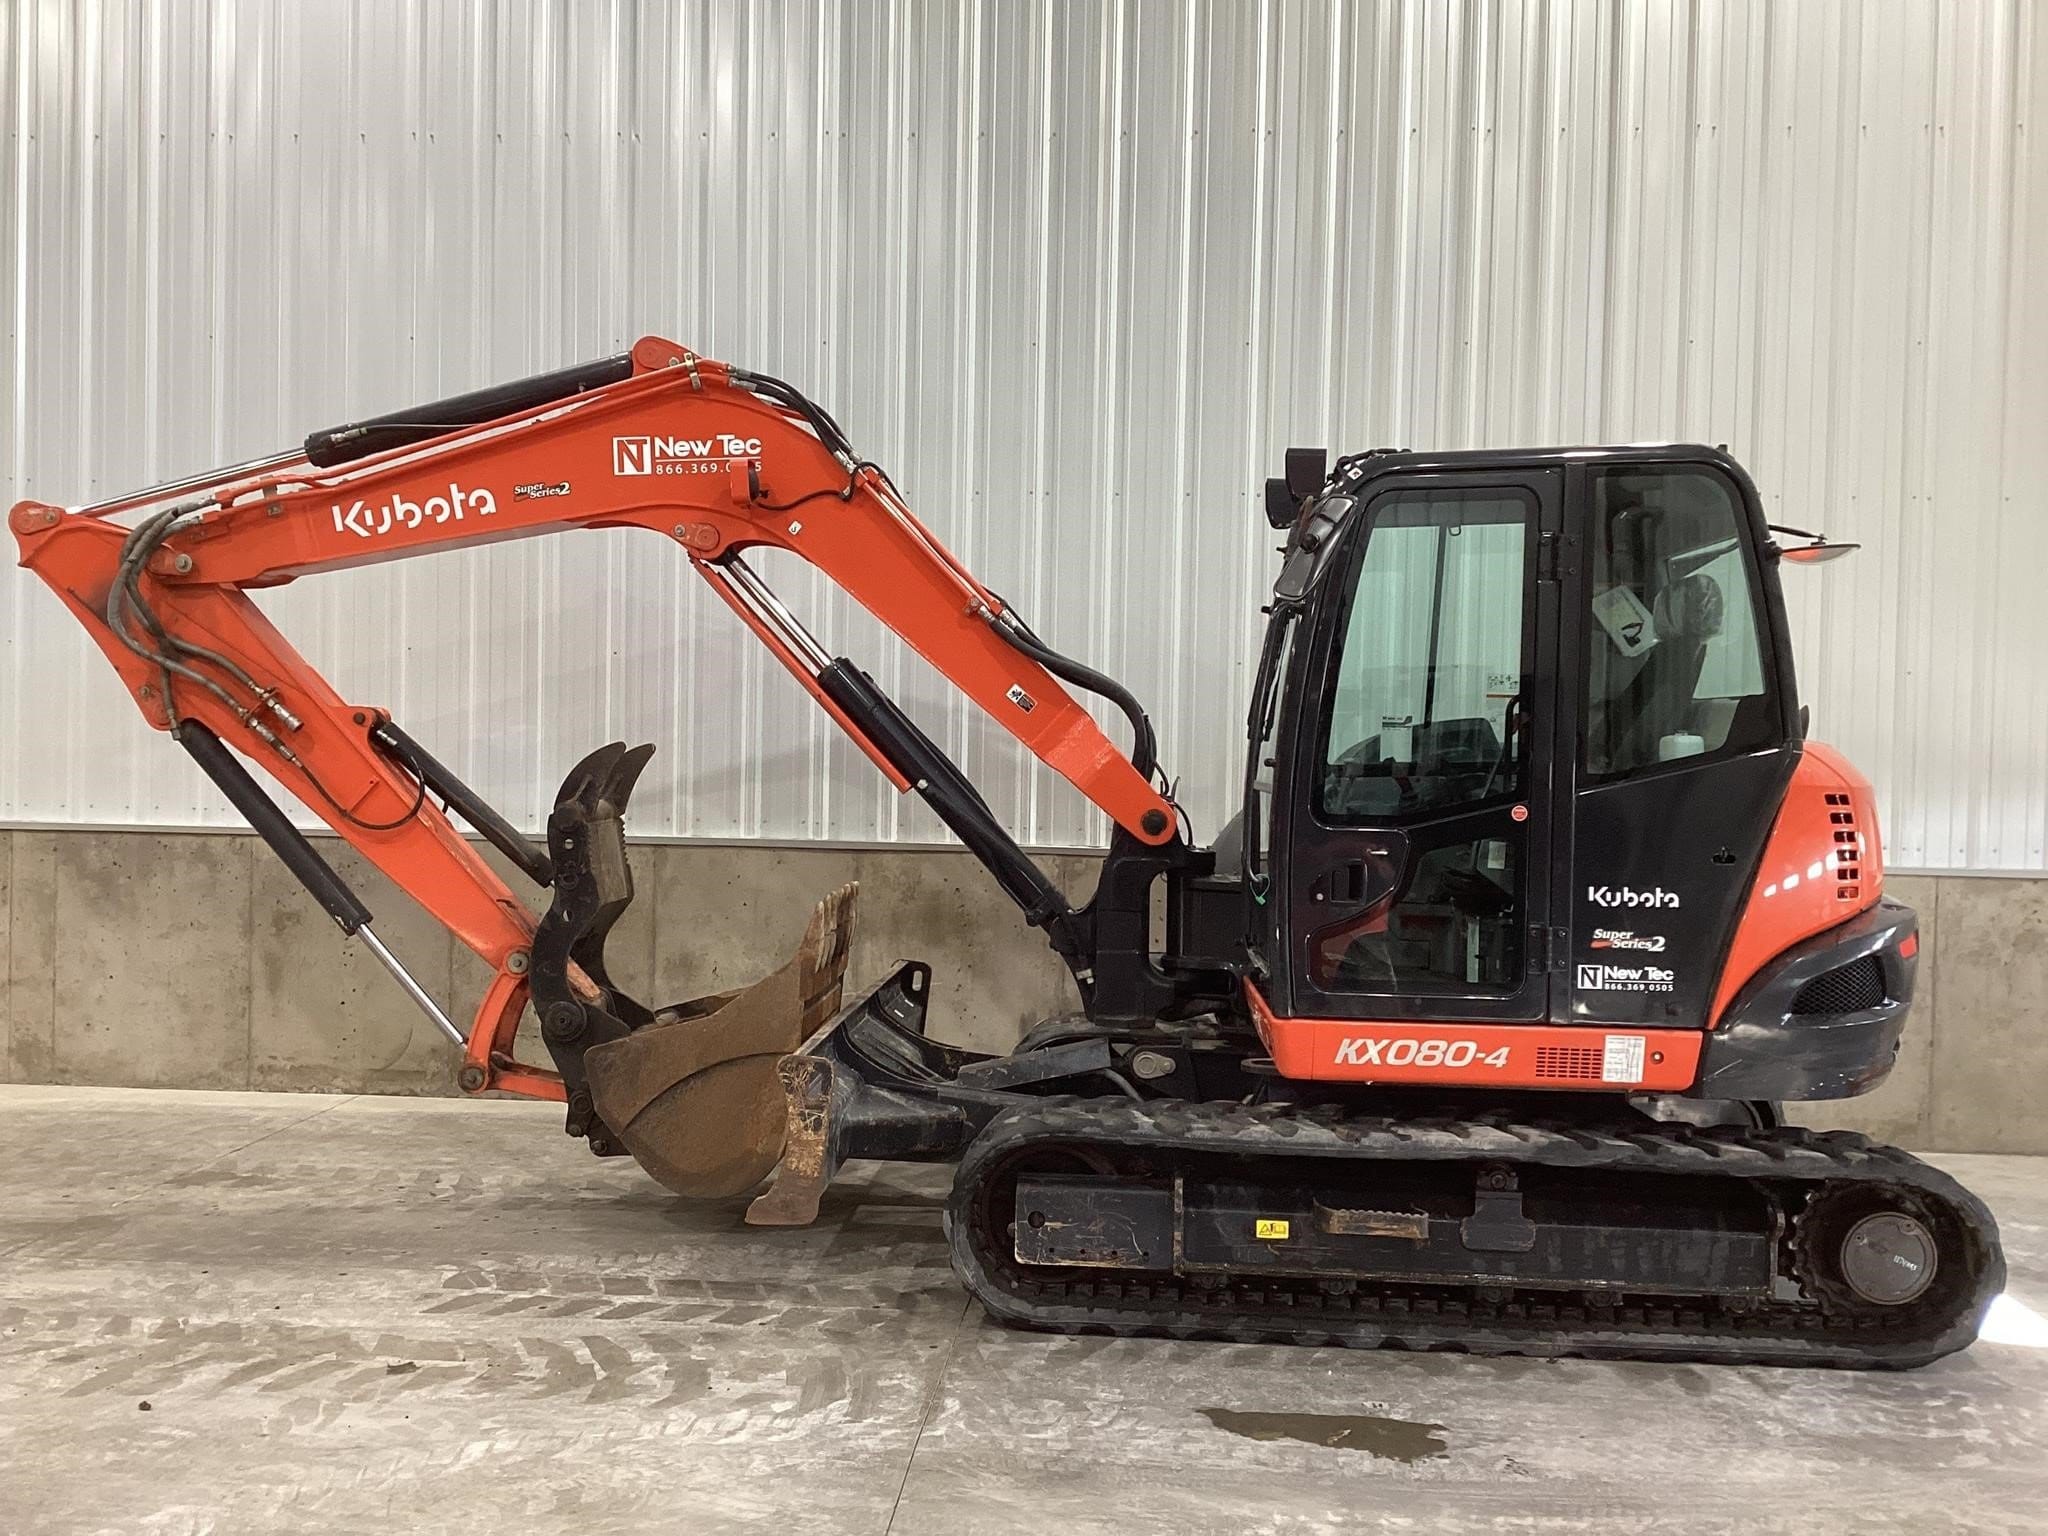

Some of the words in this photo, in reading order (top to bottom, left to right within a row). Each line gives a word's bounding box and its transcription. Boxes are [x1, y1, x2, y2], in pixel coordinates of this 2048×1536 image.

[654, 436, 713, 458] New
[716, 434, 762, 456] Tec
[656, 461, 762, 475] 866.369.05
[514, 483, 545, 495] Super
[331, 483, 497, 538] Kubota
[1588, 886, 1680, 908] Kubota
[1593, 928, 1634, 942] Super
[1604, 965, 1643, 980] New
[1643, 966, 1674, 981] Tec
[1604, 983, 1674, 993] 866.369.0505
[1334, 1038, 1511, 1068] KX080-4
